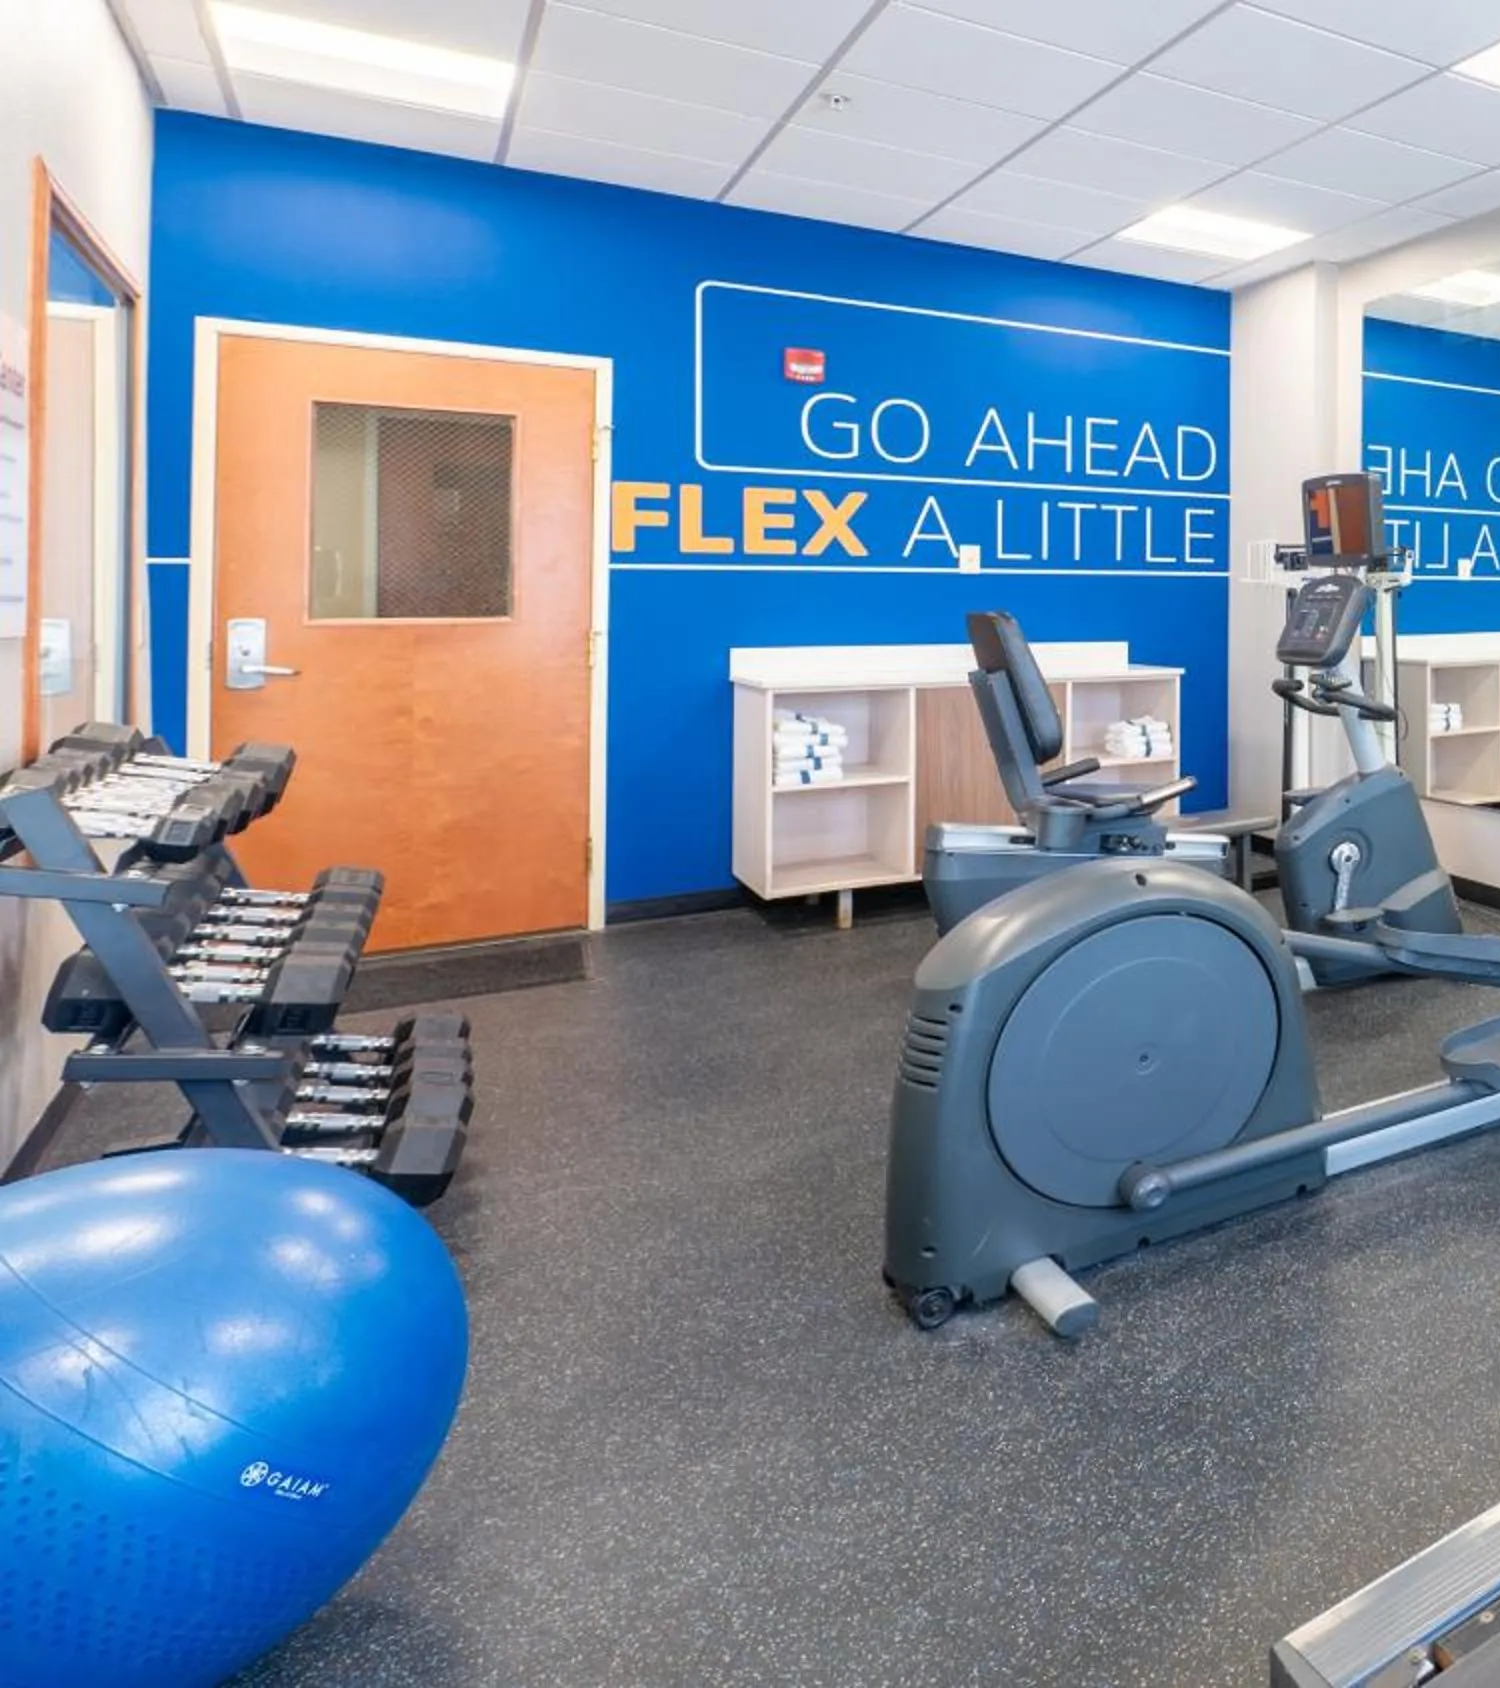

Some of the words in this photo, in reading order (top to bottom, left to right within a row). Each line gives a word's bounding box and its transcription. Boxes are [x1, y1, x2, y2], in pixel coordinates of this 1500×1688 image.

[801, 392, 931, 464] GO
[965, 407, 1217, 482] AHEAD
[611, 481, 869, 557] FLEX
[902, 496, 959, 558] A
[997, 499, 1216, 565] LITTLE
[267, 1471, 324, 1497] GAIAM
